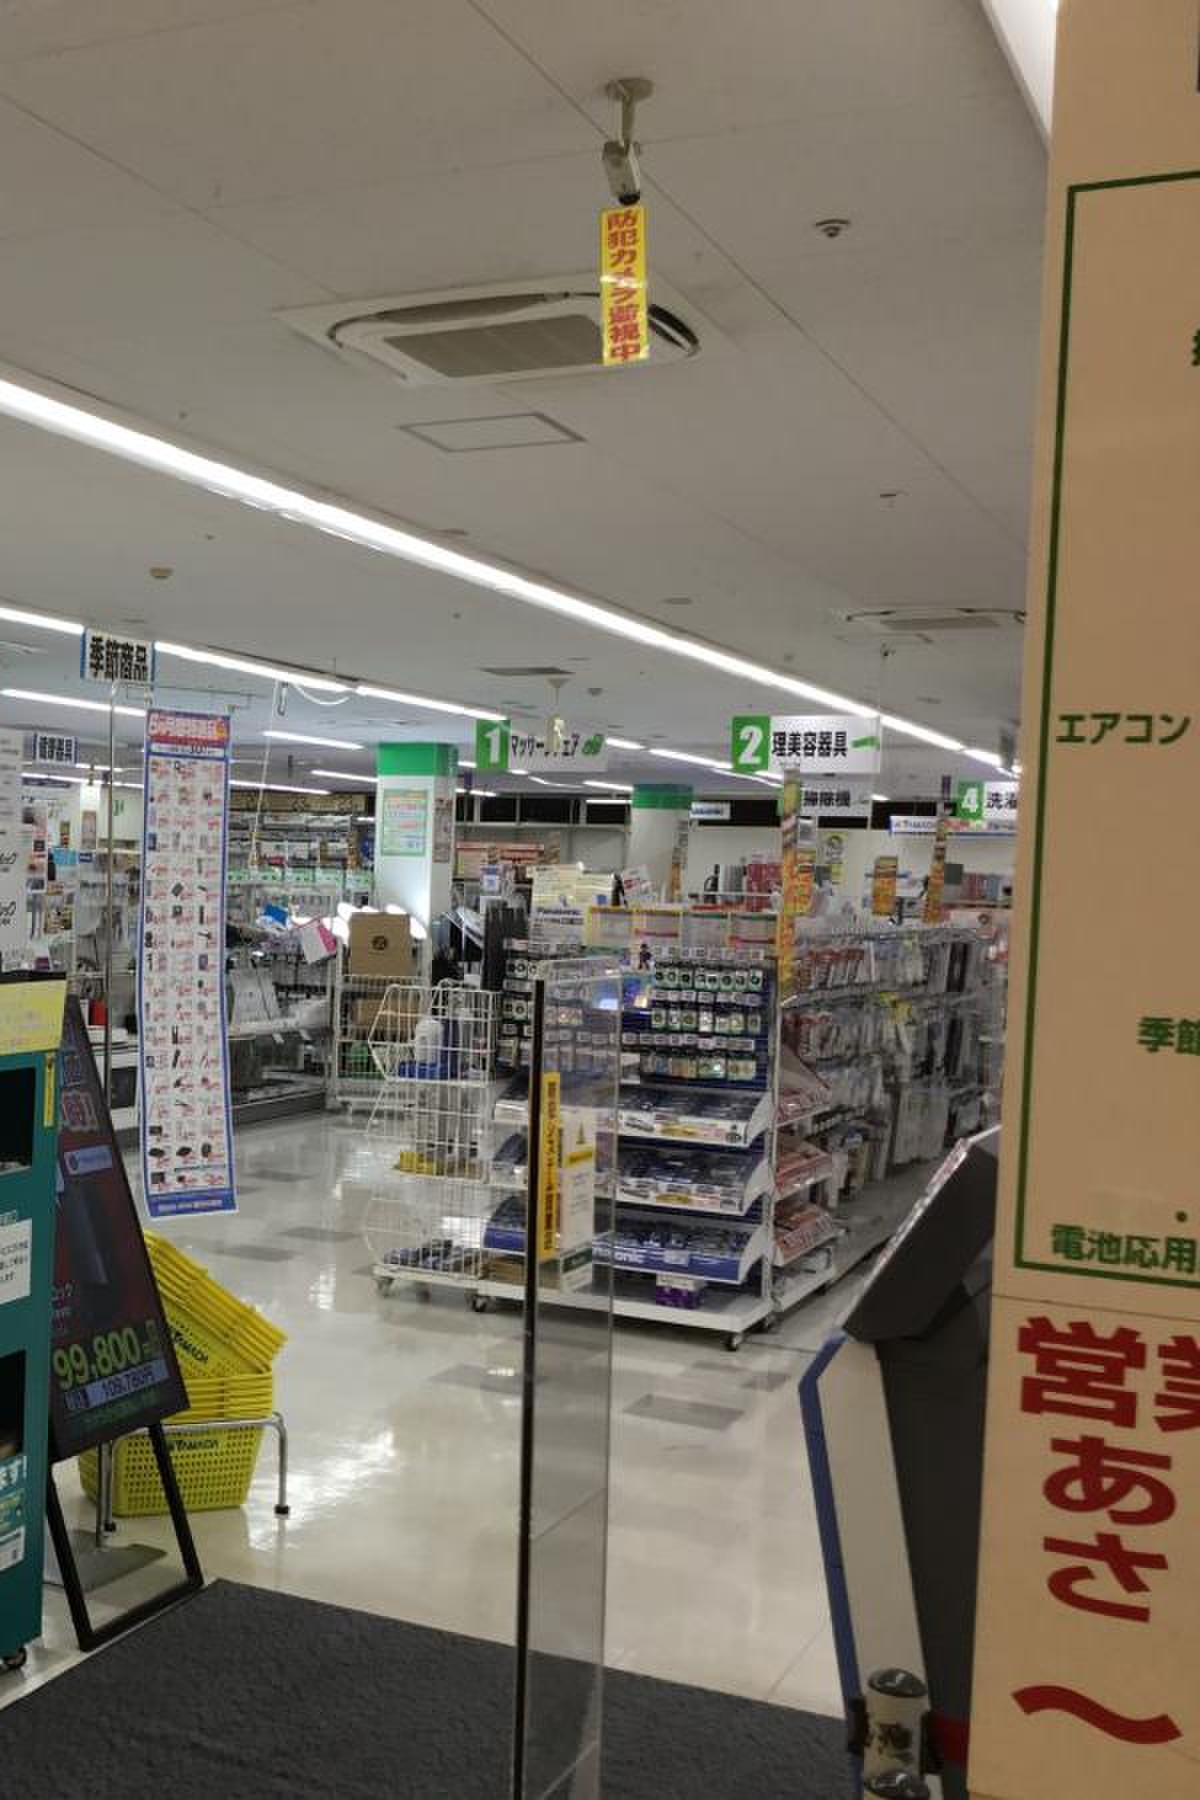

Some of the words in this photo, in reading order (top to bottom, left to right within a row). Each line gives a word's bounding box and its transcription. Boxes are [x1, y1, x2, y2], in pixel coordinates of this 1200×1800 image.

[1056, 713, 1190, 745] エアコン
[739, 727, 763, 765] 2
[771, 730, 848, 760] 理美容器具
[961, 787, 979, 813] 4
